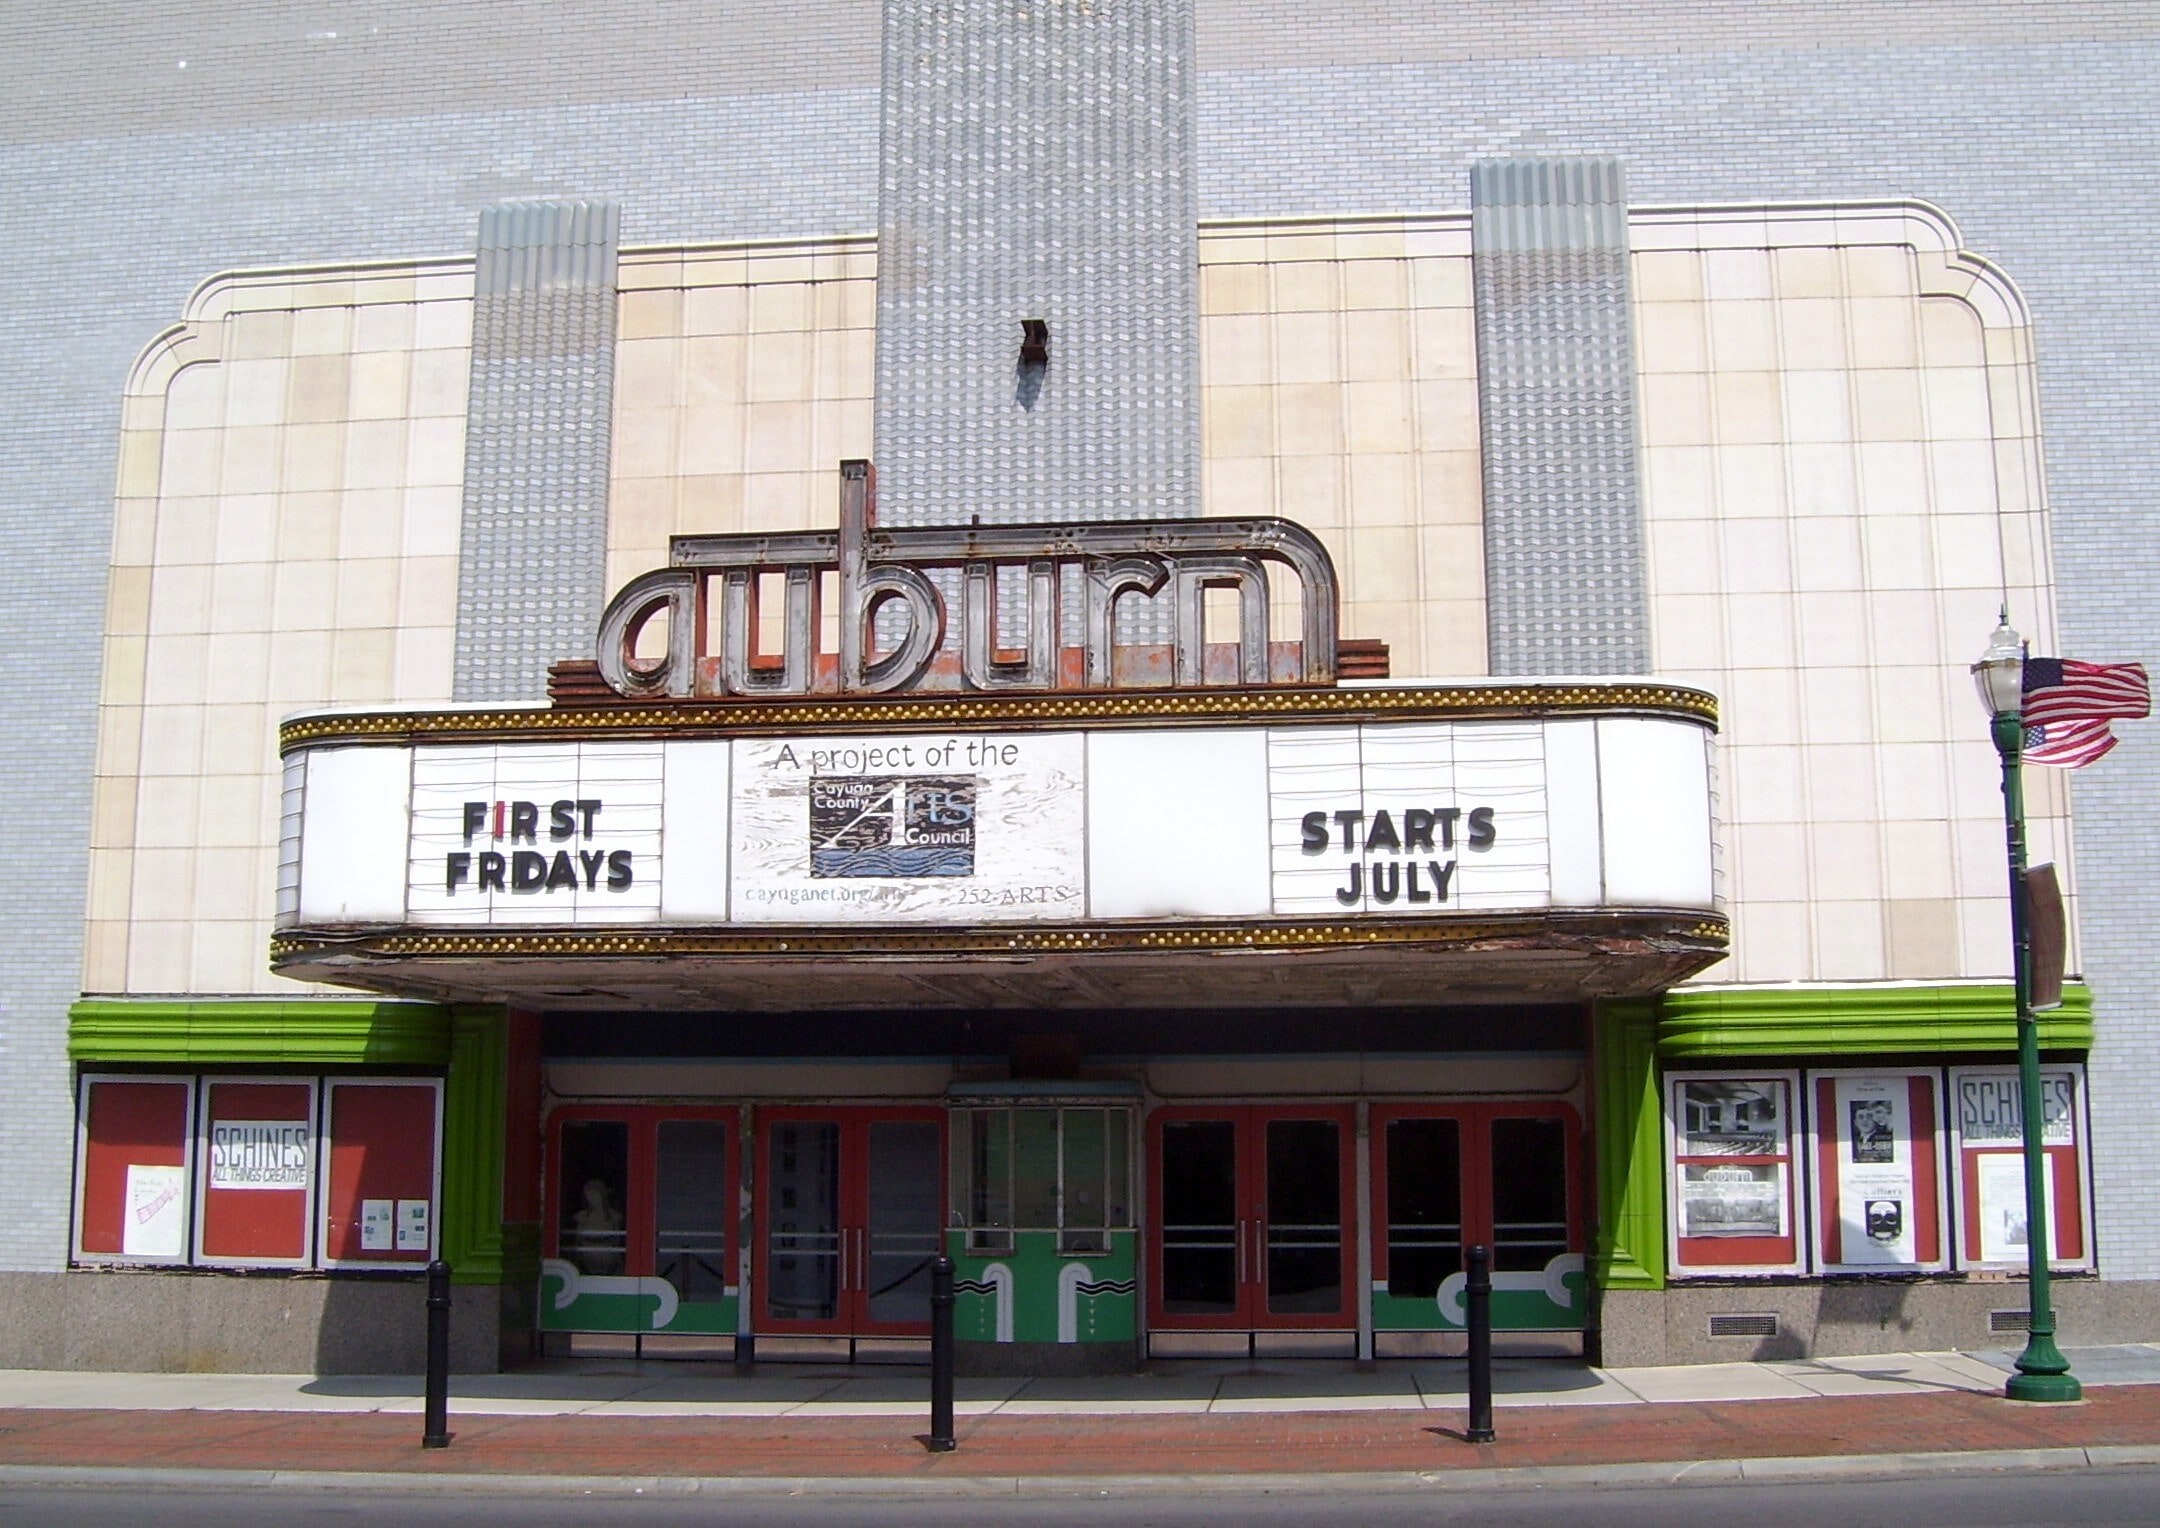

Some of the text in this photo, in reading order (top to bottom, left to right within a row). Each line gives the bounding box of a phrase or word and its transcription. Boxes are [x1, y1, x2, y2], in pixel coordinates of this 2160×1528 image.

[596, 459, 1341, 699] auburn
[773, 737, 1019, 774] A project of the
[812, 781, 874, 799] Cayuga
[814, 795, 870, 812] County
[463, 799, 602, 841] FIRST
[905, 828, 971, 845] Council
[1301, 807, 1496, 852] STARTS
[1336, 860, 1456, 904] JULY
[1963, 1080, 2070, 1125] SCHIES
[215, 1128, 308, 1168] SCHINES
[1965, 1124, 1981, 1139] ALL
[1985, 1123, 2021, 1138] THINGS
[213, 1167, 306, 1184] ALL THINGS CREATIVE
